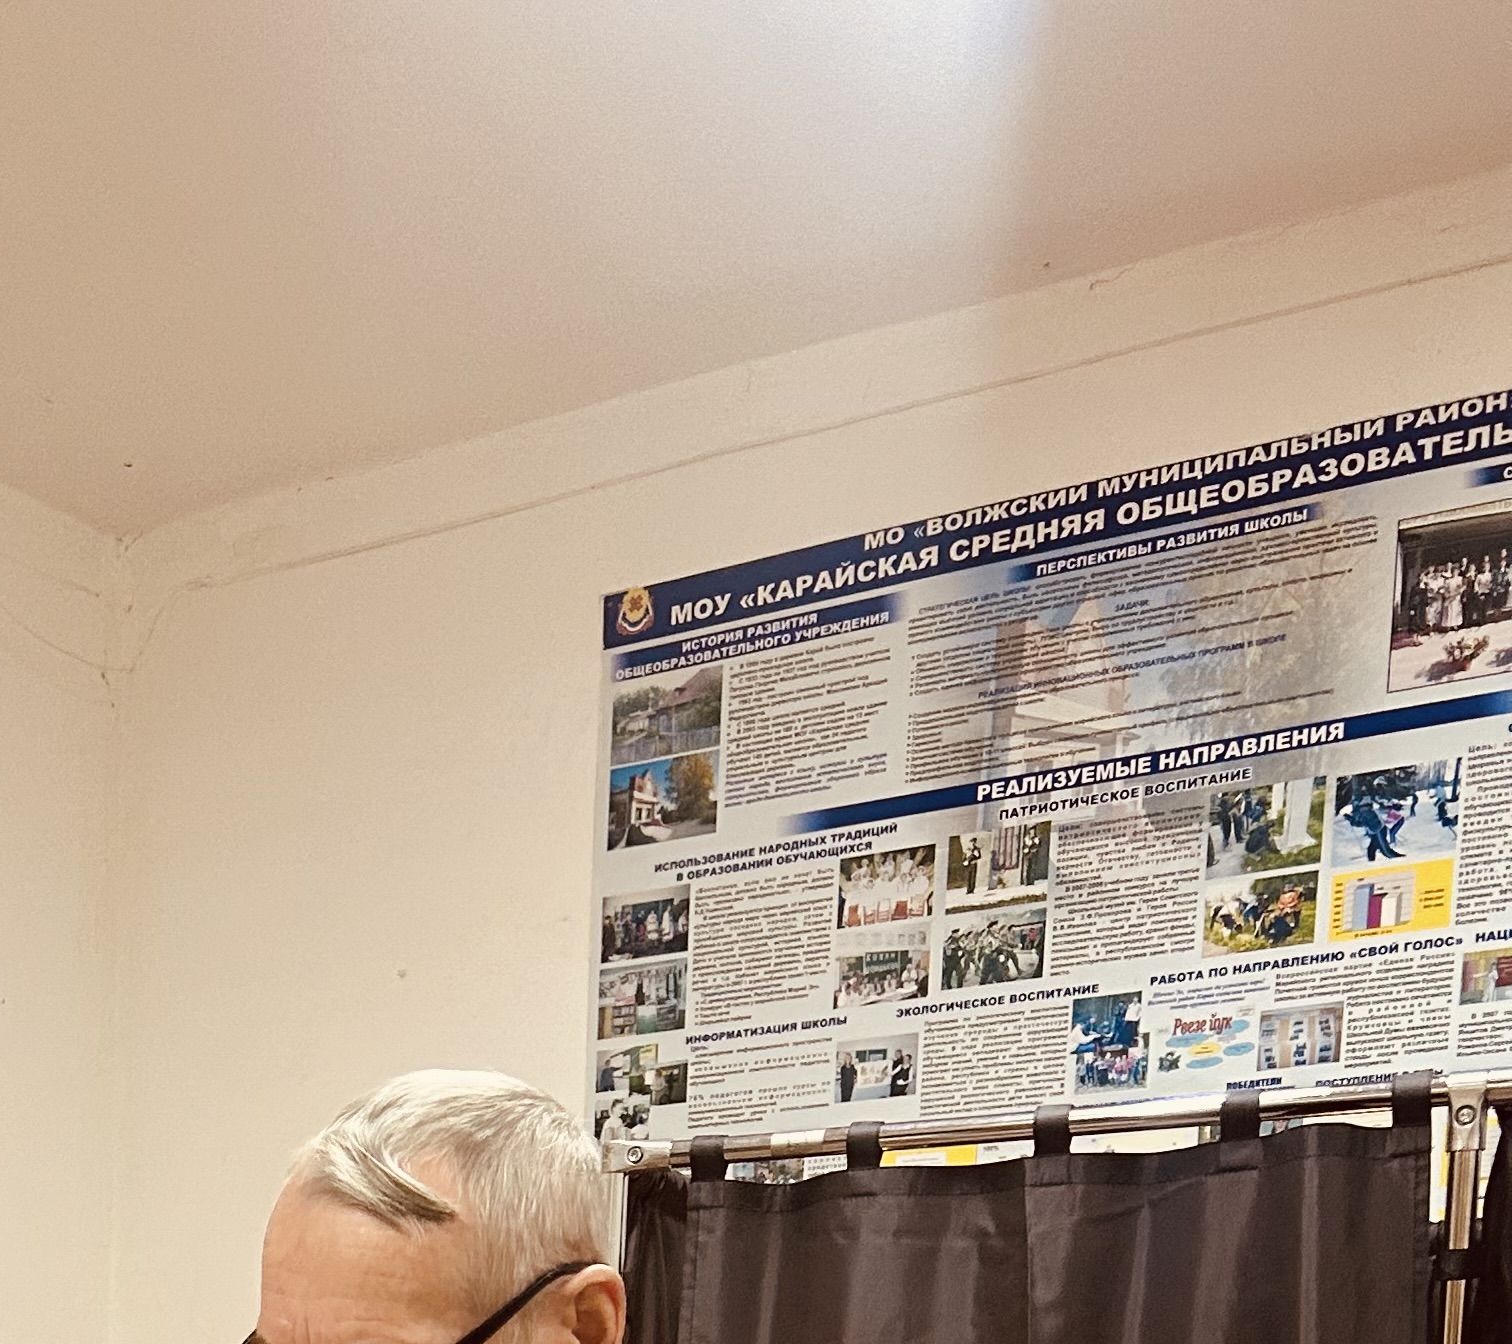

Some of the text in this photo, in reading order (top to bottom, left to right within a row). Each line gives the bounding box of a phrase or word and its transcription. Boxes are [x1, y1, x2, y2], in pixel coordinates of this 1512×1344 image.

[864, 527, 904, 550] МО
[1395, 392, 1512, 432] РАЙОН
[670, 593, 731, 626] МОУ
[740, 546, 939, 608] «КАРАЙСКАЯ
[949, 508, 1105, 562] СРЕДНЯЯ
[1036, 508, 1308, 577] ПЕРСПЕКТИВЫ РАЗВИТИЯ ШКОЛЫ
[615, 611, 890, 681] ОБЩЕОБРАЗОВАТЕЛЬНОГО УЧРЕЖДЕНИЯ
[682, 613, 818, 653] ИСТОРИЯ РАЗВИТИЯ
[976, 757, 1152, 802] РЕАЛИЗУЕМЫЕ
[1158, 722, 1345, 770] НАПРАВЛЕНИЯ
[999, 767, 1252, 820] ПАТРИОТИЧЕСКОЕ ВОСПИТАНИЕ
[654, 822, 898, 873] ИСПОЛЬЗОВАНИЕ НАРОДНЫХ ТРАДИЦИЙ
[676, 841, 873, 882] В ОБРАЗОВАНИИ ОБУЧАЮЩИХСЯ
[1150, 969, 1204, 986] РАБОТА
[1209, 966, 1228, 978] ПО
[1232, 951, 1345, 975] НАПРАВЛЕНИЮ
[1350, 942, 1399, 960] «СВОЙ
[1403, 936, 1463, 953] ГОЛОС»
[896, 983, 1100, 1018] ЭКОЛОГИЧЕСКОЕ ВОСПИТАНИЕ
[686, 1016, 848, 1045] ИНФОРМАТИЗАЦИЯ ШКОЛЫ
[1226, 1077, 1282, 1090] ПОБЕДИТЕЛИ
